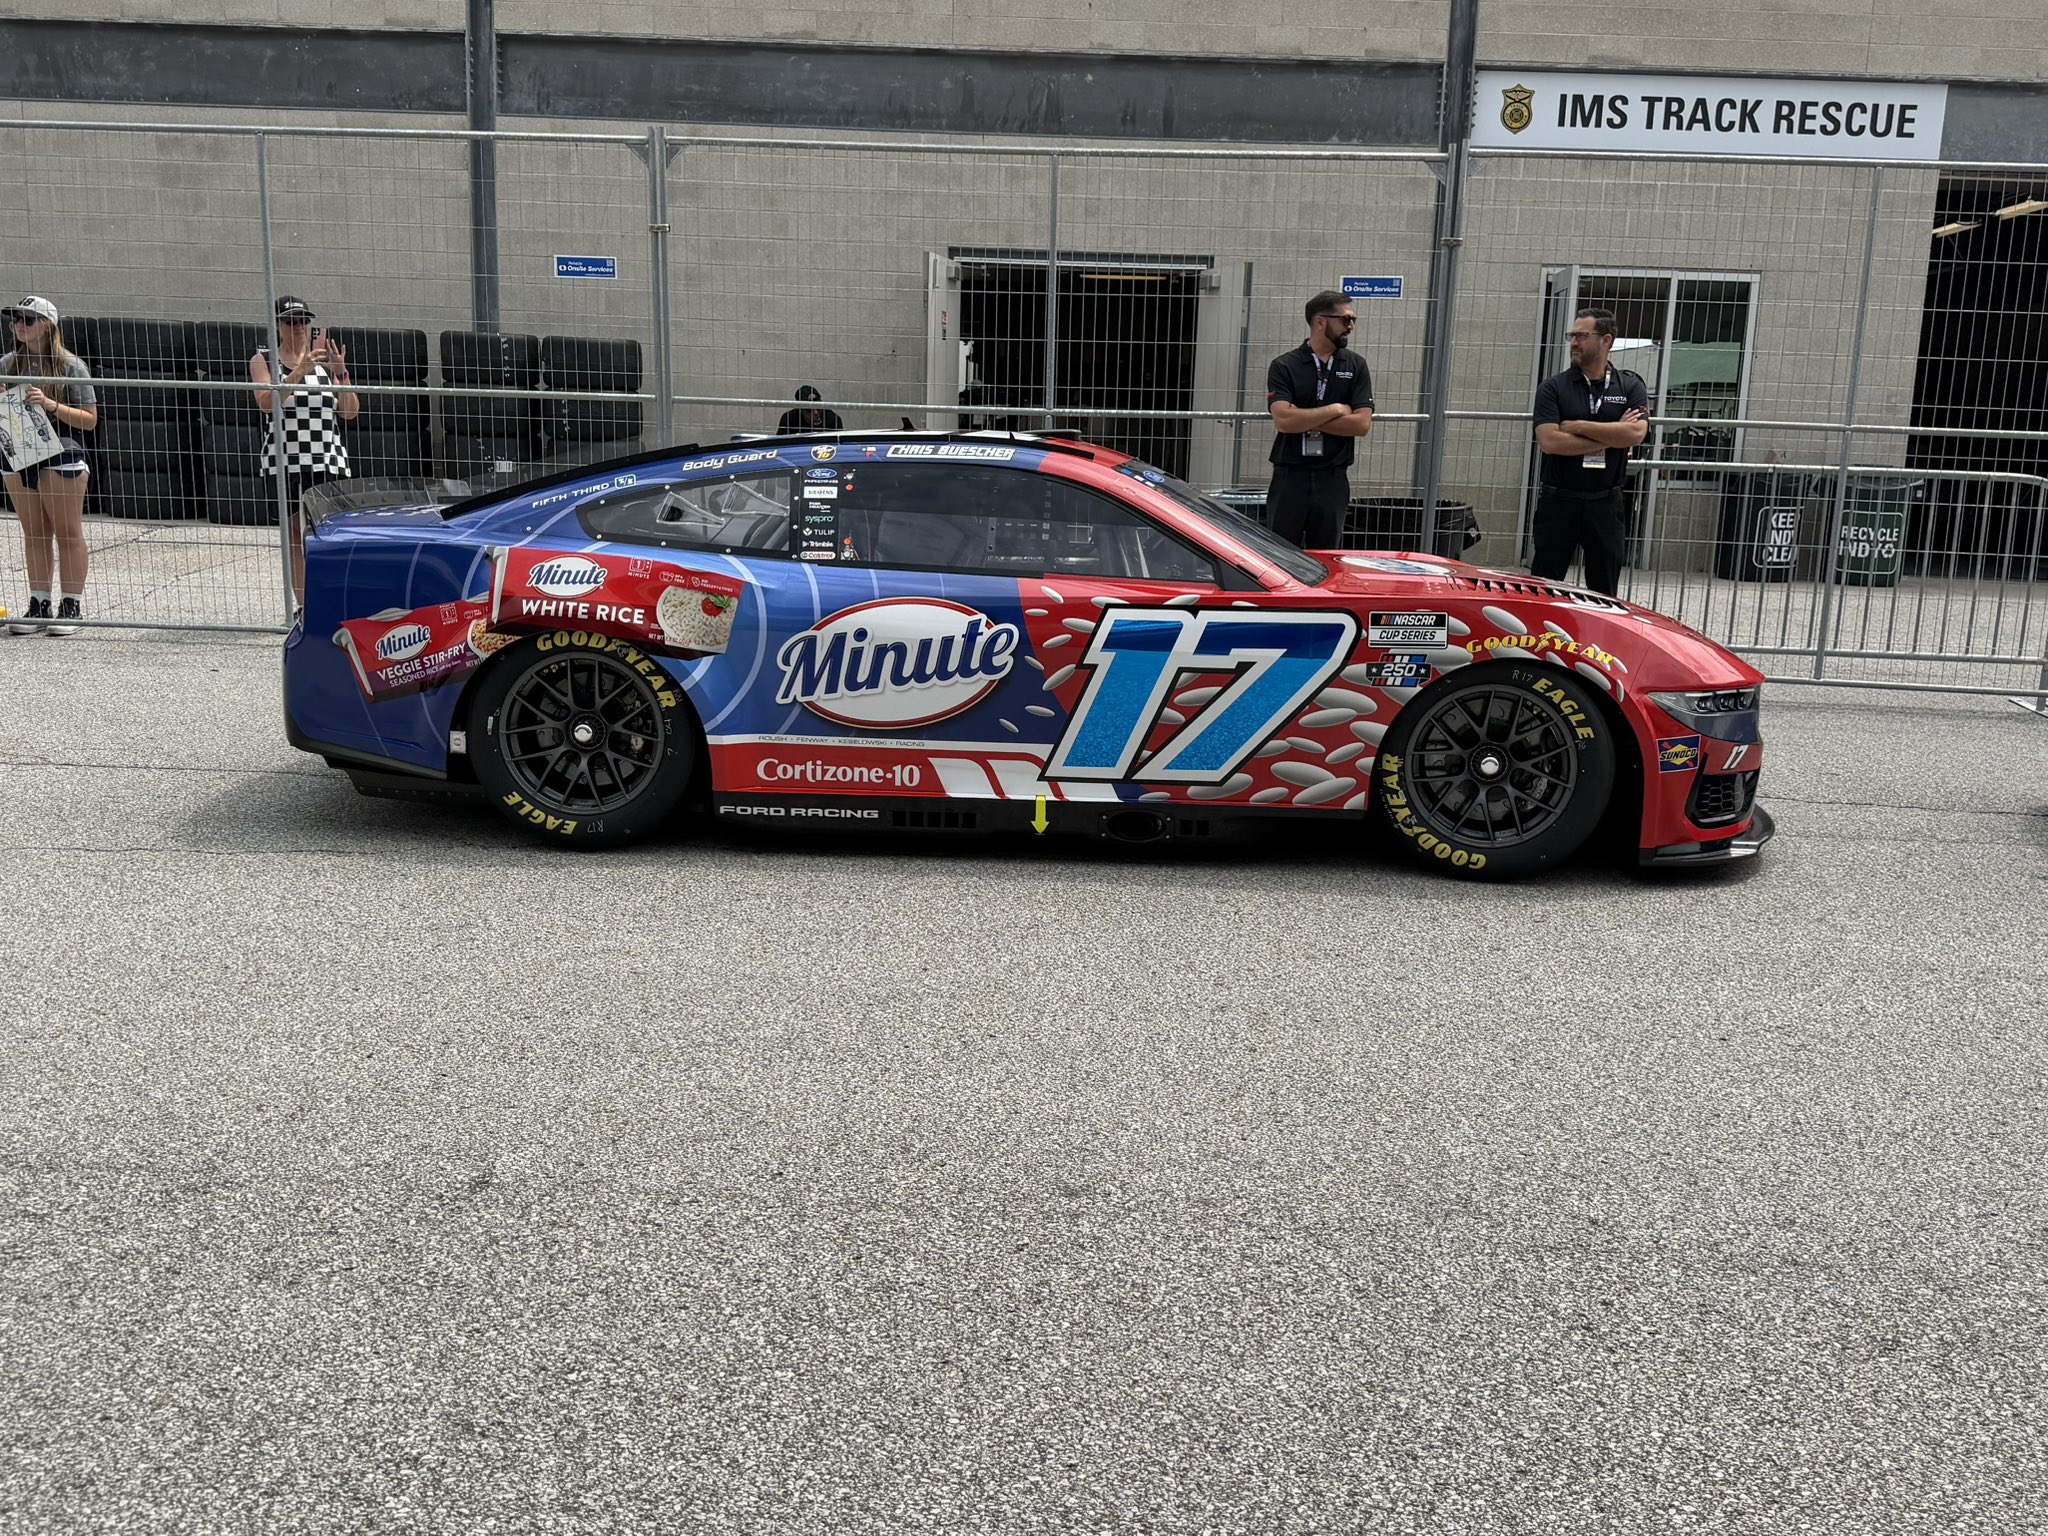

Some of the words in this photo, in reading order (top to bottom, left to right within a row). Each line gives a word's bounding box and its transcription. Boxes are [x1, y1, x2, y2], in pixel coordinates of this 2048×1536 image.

[1557, 93, 1629, 129] IMS
[1641, 96, 1763, 134] TRACK
[1772, 100, 1918, 139] RESCUE
[682, 457, 725, 471] Body
[727, 449, 777, 464] Guard
[887, 444, 936, 457] CHRIS
[937, 446, 1016, 460] BUESCHER
[532, 494, 568, 508] FIFTH
[571, 483, 610, 497] THIRD
[804, 515, 835, 523] syspro
[1771, 512, 1800, 528] KEE
[1841, 525, 1900, 541] RECYCLE
[1762, 546, 1799, 562] CLE
[1838, 540, 1883, 558] INDY
[527, 562, 608, 587] Minute
[522, 599, 591, 620] WHITE
[596, 604, 646, 625] RICE
[1393, 614, 1437, 626] NASCAR
[375, 624, 431, 660] Minute
[1379, 630, 1401, 640] CUP
[1400, 630, 1437, 640] SERIES
[776, 613, 1019, 704] Minute
[1465, 631, 1614, 665] GOODYEAR
[376, 658, 423, 681] VEGGIE
[422, 641, 467, 668] STIR-FRY
[536, 630, 677, 710] GOODYEAR
[1381, 663, 1417, 677] 250
[389, 670, 426, 688] SEASONED
[425, 664, 440, 676] RICE
[1038, 603, 1362, 786] 17
[1531, 677, 1596, 741] EAGLE
[1659, 747, 1698, 761] SUNOCO
[1721, 744, 1750, 771] 17
[502, 791, 579, 836] EAGLE
[719, 805, 785, 817] FORD
[790, 807, 879, 819] RACING
[1381, 753, 1488, 871] GOODYEAR
